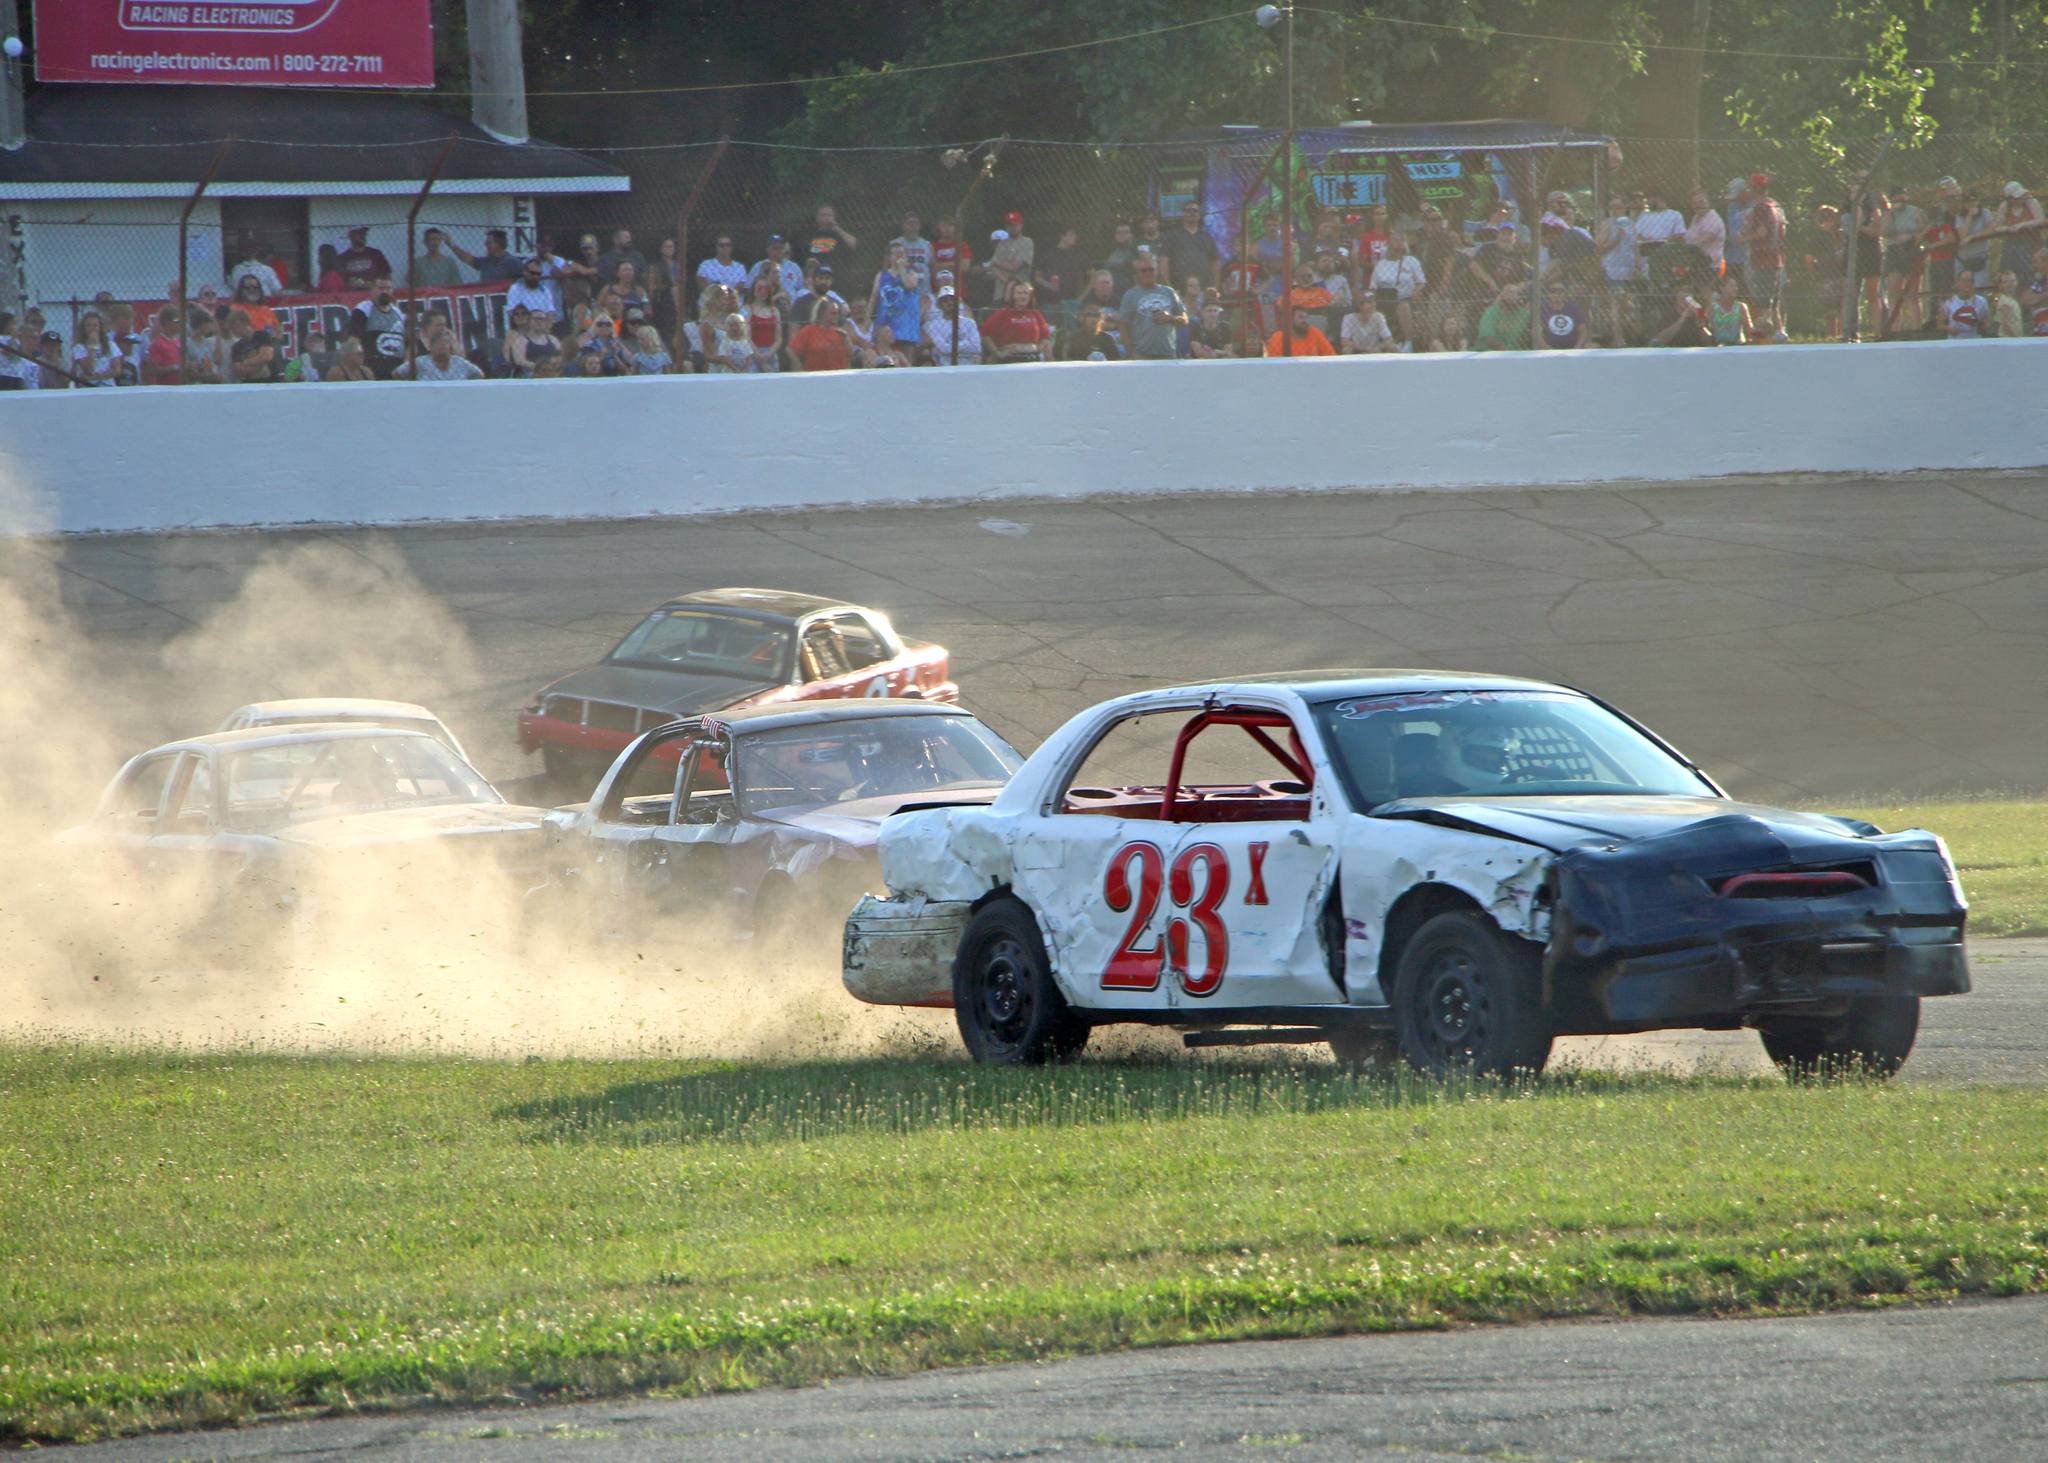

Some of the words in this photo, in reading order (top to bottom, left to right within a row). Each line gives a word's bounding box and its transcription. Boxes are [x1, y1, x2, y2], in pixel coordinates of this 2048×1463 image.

[129, 6, 188, 24] RACING
[193, 7, 295, 25] ELECTRONICS
[90, 51, 270, 74] racingelectronics.com
[283, 55, 383, 73] 800-272-7111
[1100, 840, 1231, 998] 23
